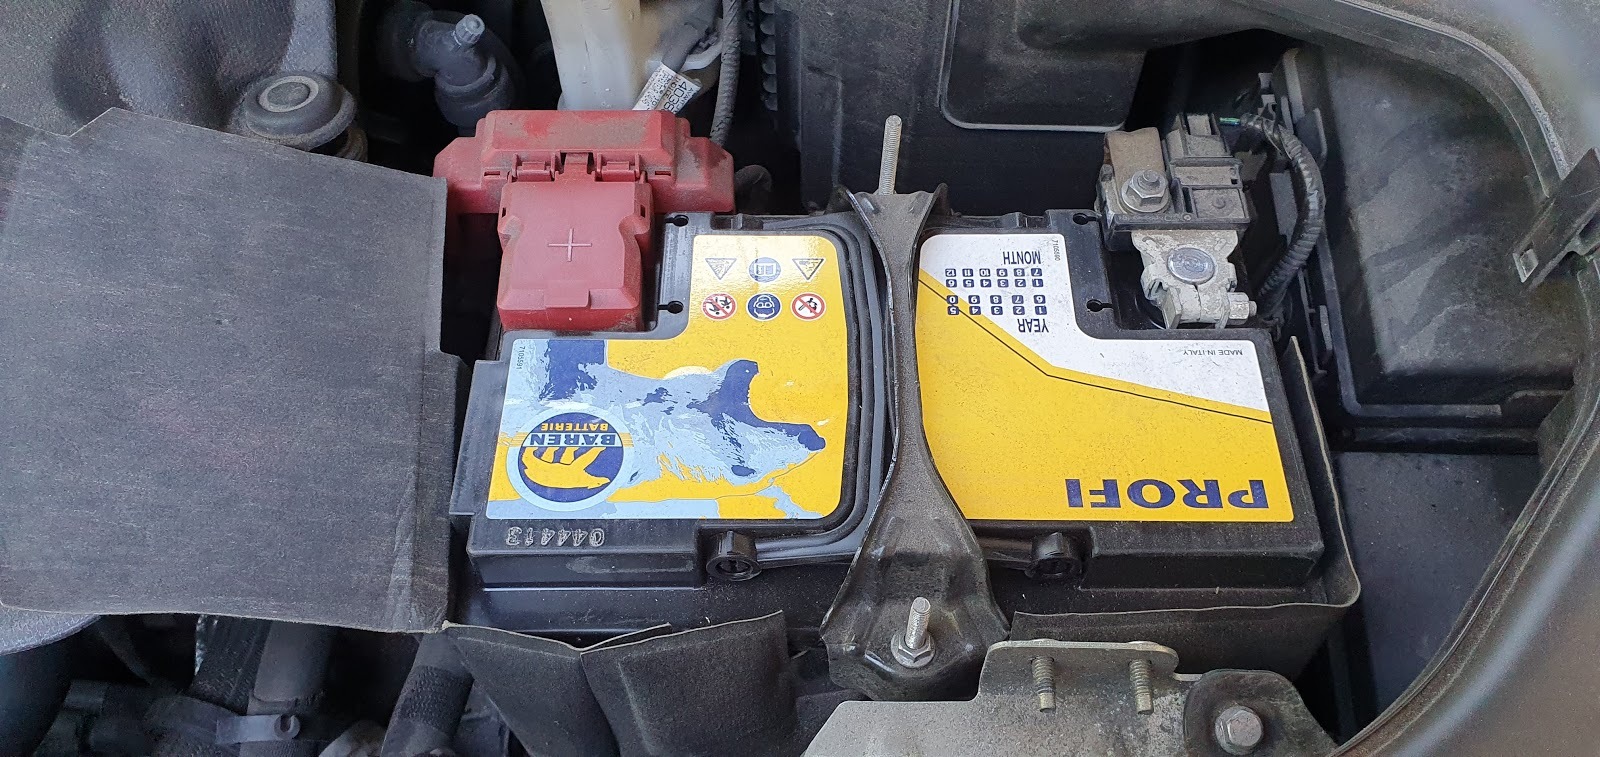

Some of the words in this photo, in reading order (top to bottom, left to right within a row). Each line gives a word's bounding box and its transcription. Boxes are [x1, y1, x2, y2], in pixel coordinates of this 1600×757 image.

[661, 81, 688, 111] 4038
[1002, 250, 1041, 265] MONTH
[945, 268, 956, 277] 12
[962, 268, 973, 277] 11
[979, 268, 990, 277] 10
[997, 268, 1007, 277] 9
[1014, 268, 1024, 277] 8
[1032, 268, 1042, 277] 7
[946, 279, 956, 287] 6
[964, 279, 974, 287] 5
[981, 279, 991, 287] 4
[998, 279, 1008, 287] 3
[1016, 279, 1026, 287] 2
[1033, 279, 1043, 287] 1
[947, 295, 957, 304] 0
[969, 295, 979, 304] 9
[991, 295, 1001, 304] 8
[1013, 295, 1023, 304] 7
[1035, 295, 1045, 304] 6
[948, 306, 958, 315] 5
[970, 306, 980, 315] 4
[992, 306, 1002, 315] 3
[1014, 306, 1024, 315] 2
[1036, 306, 1046, 315] 1
[1017, 319, 1049, 333] YEAR
[541, 423, 609, 431] BATTERIE
[529, 434, 616, 446] BÄREN
[1065, 479, 1269, 508] PROFI
